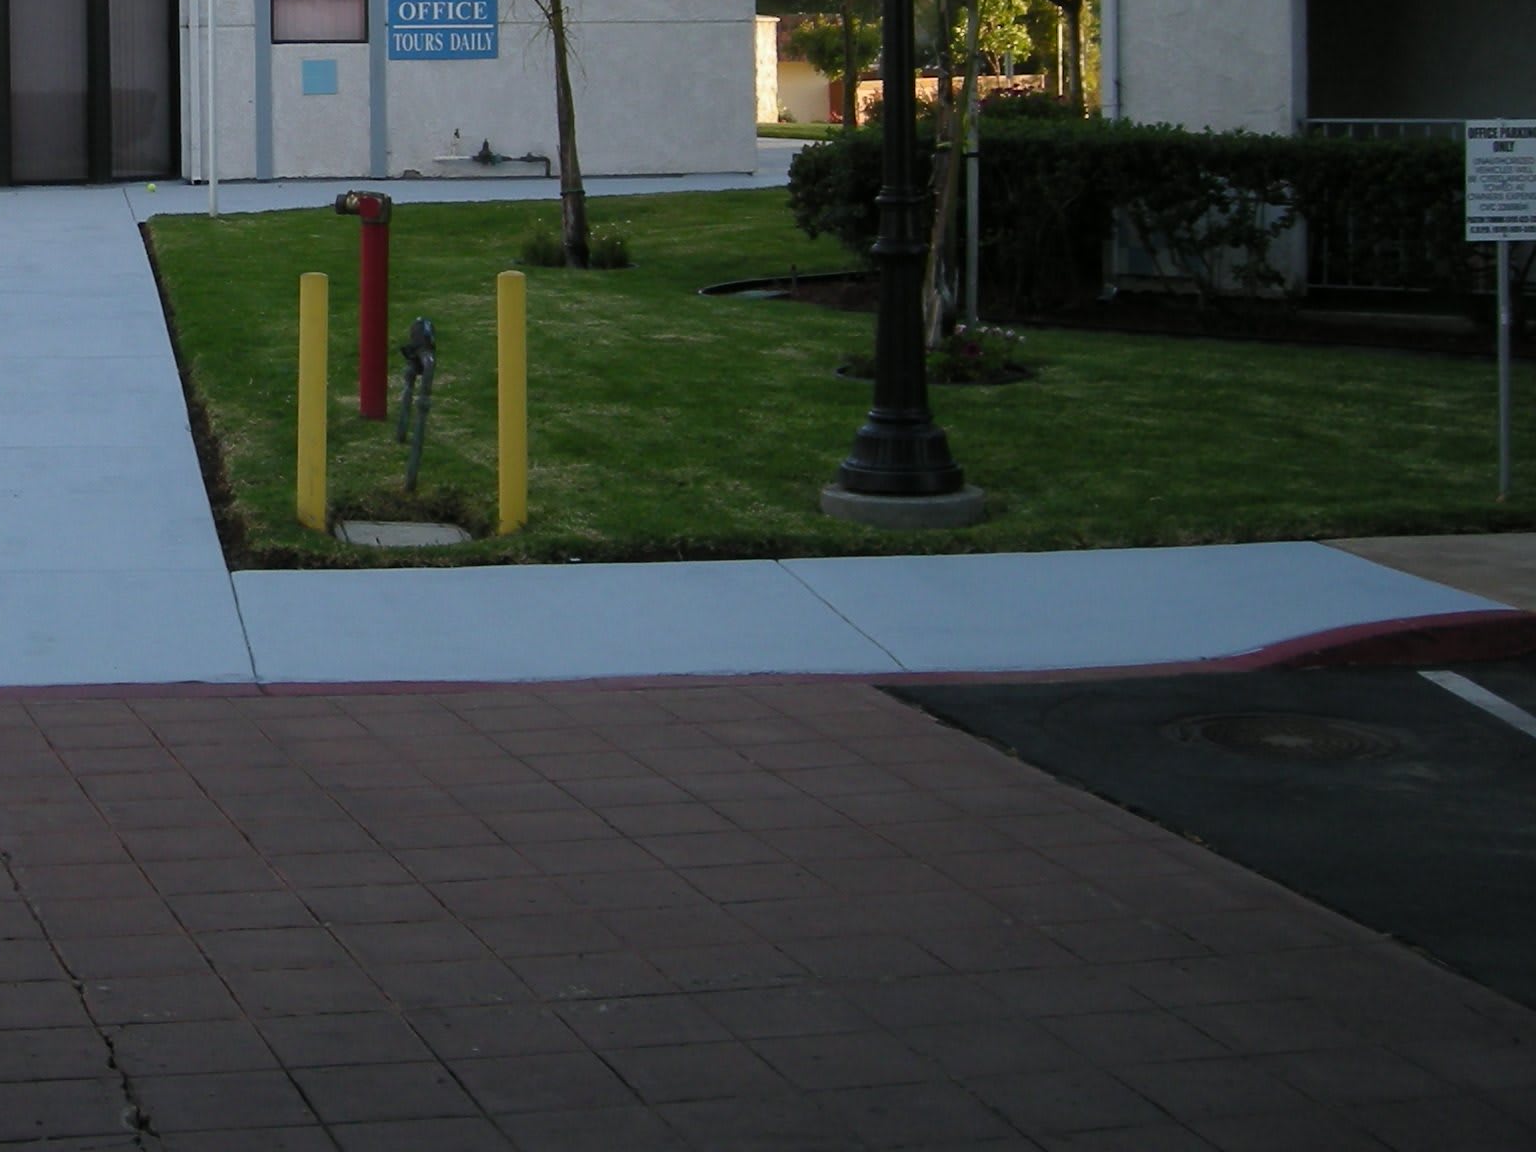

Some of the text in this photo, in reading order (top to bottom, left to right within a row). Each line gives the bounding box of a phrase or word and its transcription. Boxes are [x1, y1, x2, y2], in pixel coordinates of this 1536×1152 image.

[398, 1, 488, 21] OFFICE
[393, 32, 494, 52] TOURS DAILY
[1468, 127, 1498, 139] OFFICE
[1493, 141, 1515, 152] ONLY
